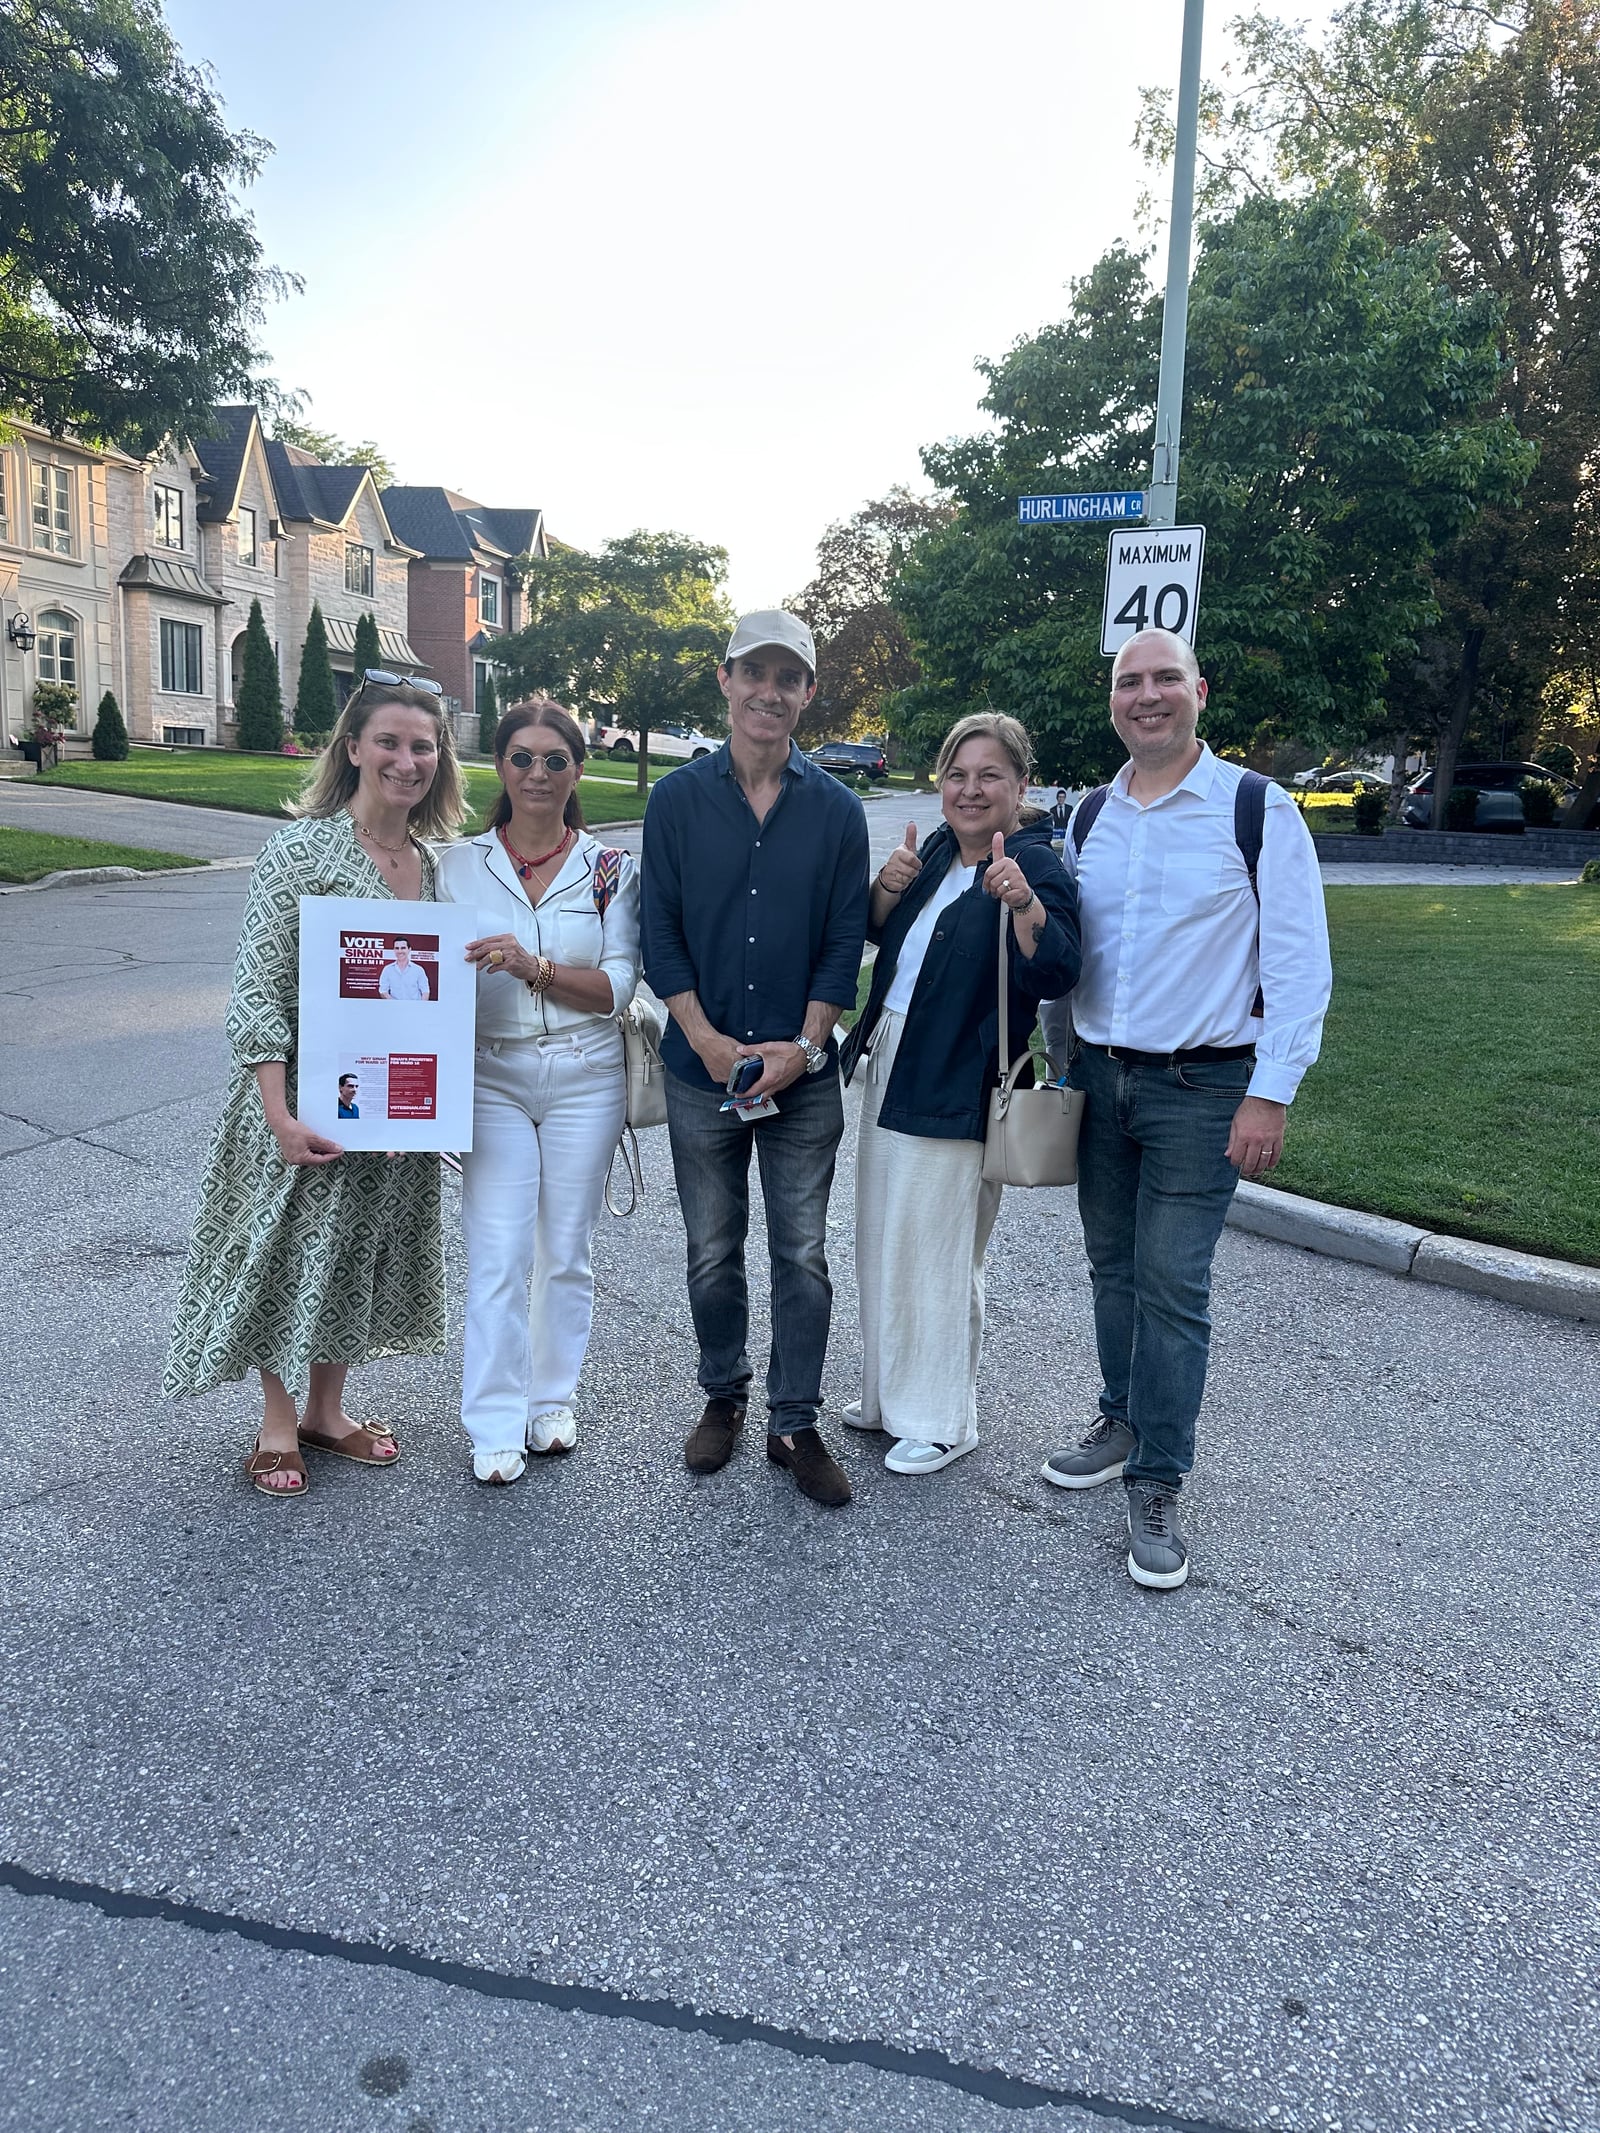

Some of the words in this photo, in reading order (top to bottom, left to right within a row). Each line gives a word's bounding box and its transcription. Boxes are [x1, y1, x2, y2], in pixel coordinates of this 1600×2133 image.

[1019, 496, 1126, 520] HURLINGHAM
[1131, 499, 1142, 511] CR
[1119, 544, 1192, 565] MAXIMUM
[1113, 583, 1189, 634] 40
[344, 936, 385, 949] VOTE
[345, 949, 383, 958] SINAN
